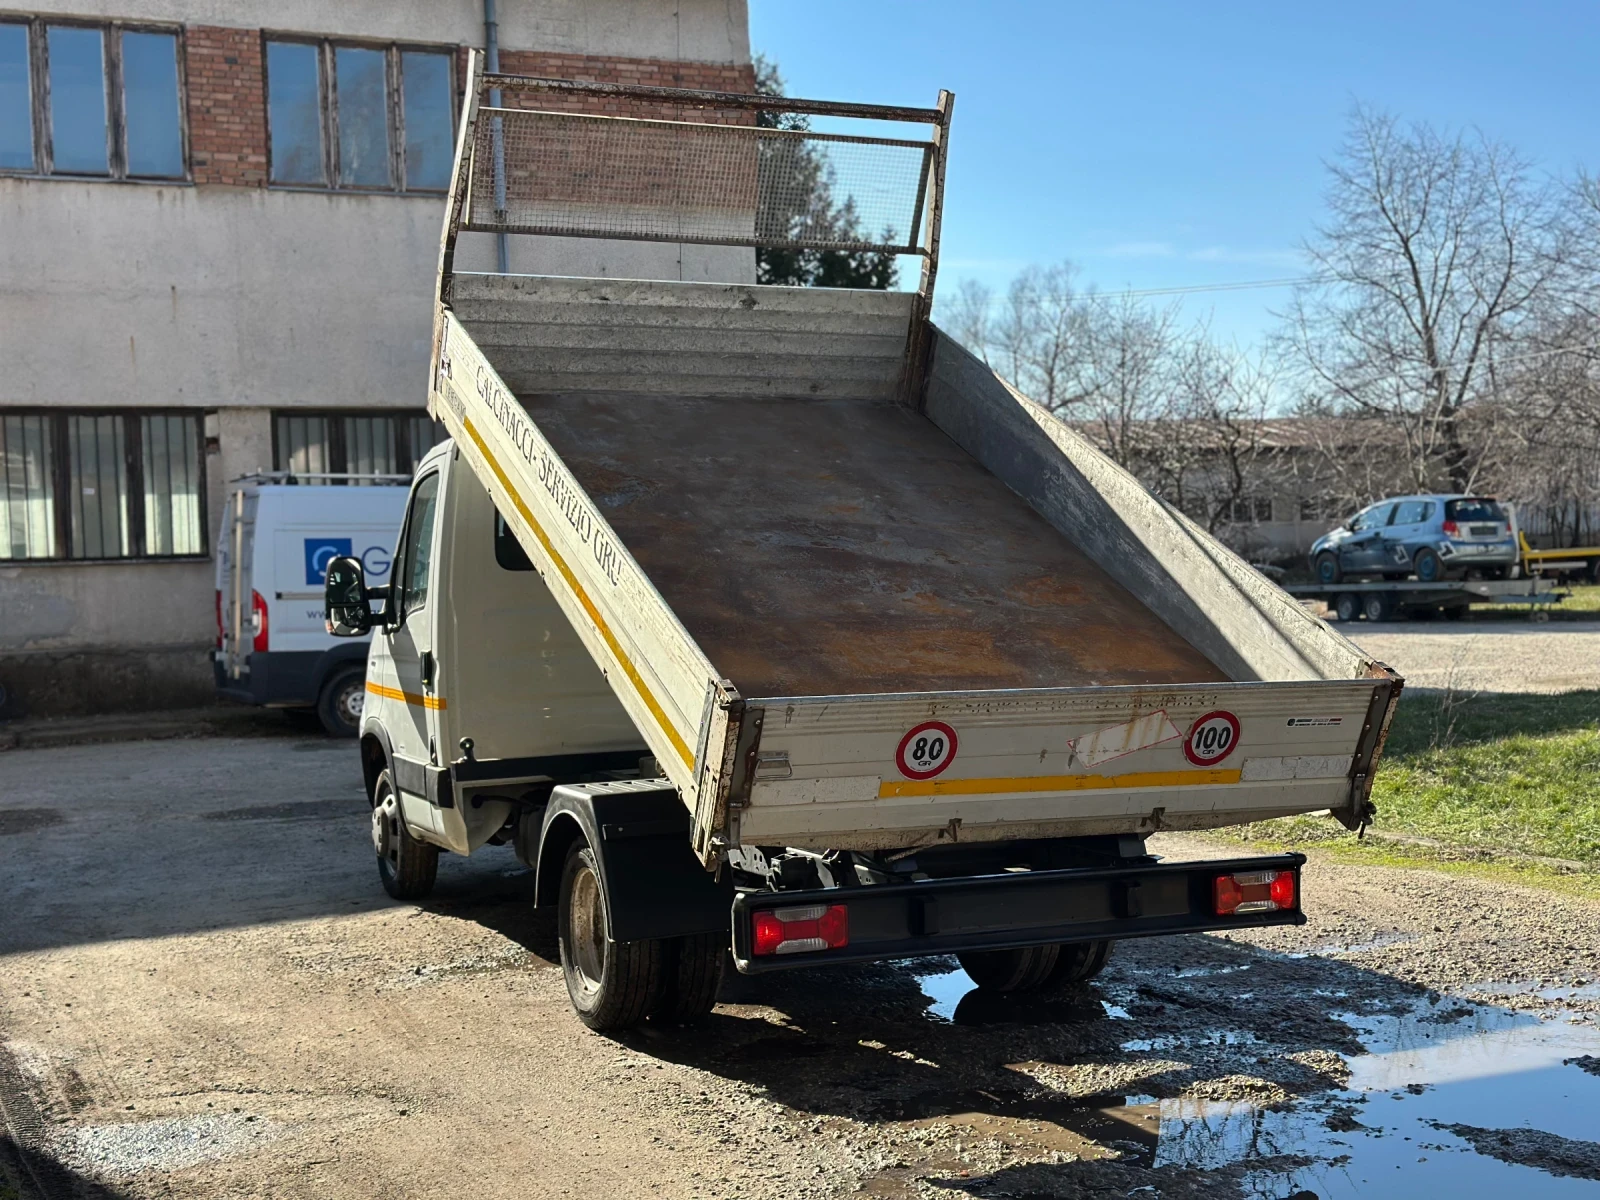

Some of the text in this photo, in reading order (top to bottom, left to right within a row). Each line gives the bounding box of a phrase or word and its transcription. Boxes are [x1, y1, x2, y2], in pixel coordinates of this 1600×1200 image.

[538, 453, 591, 544] SERVIZIO
[593, 529, 621, 586] GRU
[912, 737, 944, 760] 80
[1195, 726, 1231, 749] 100
